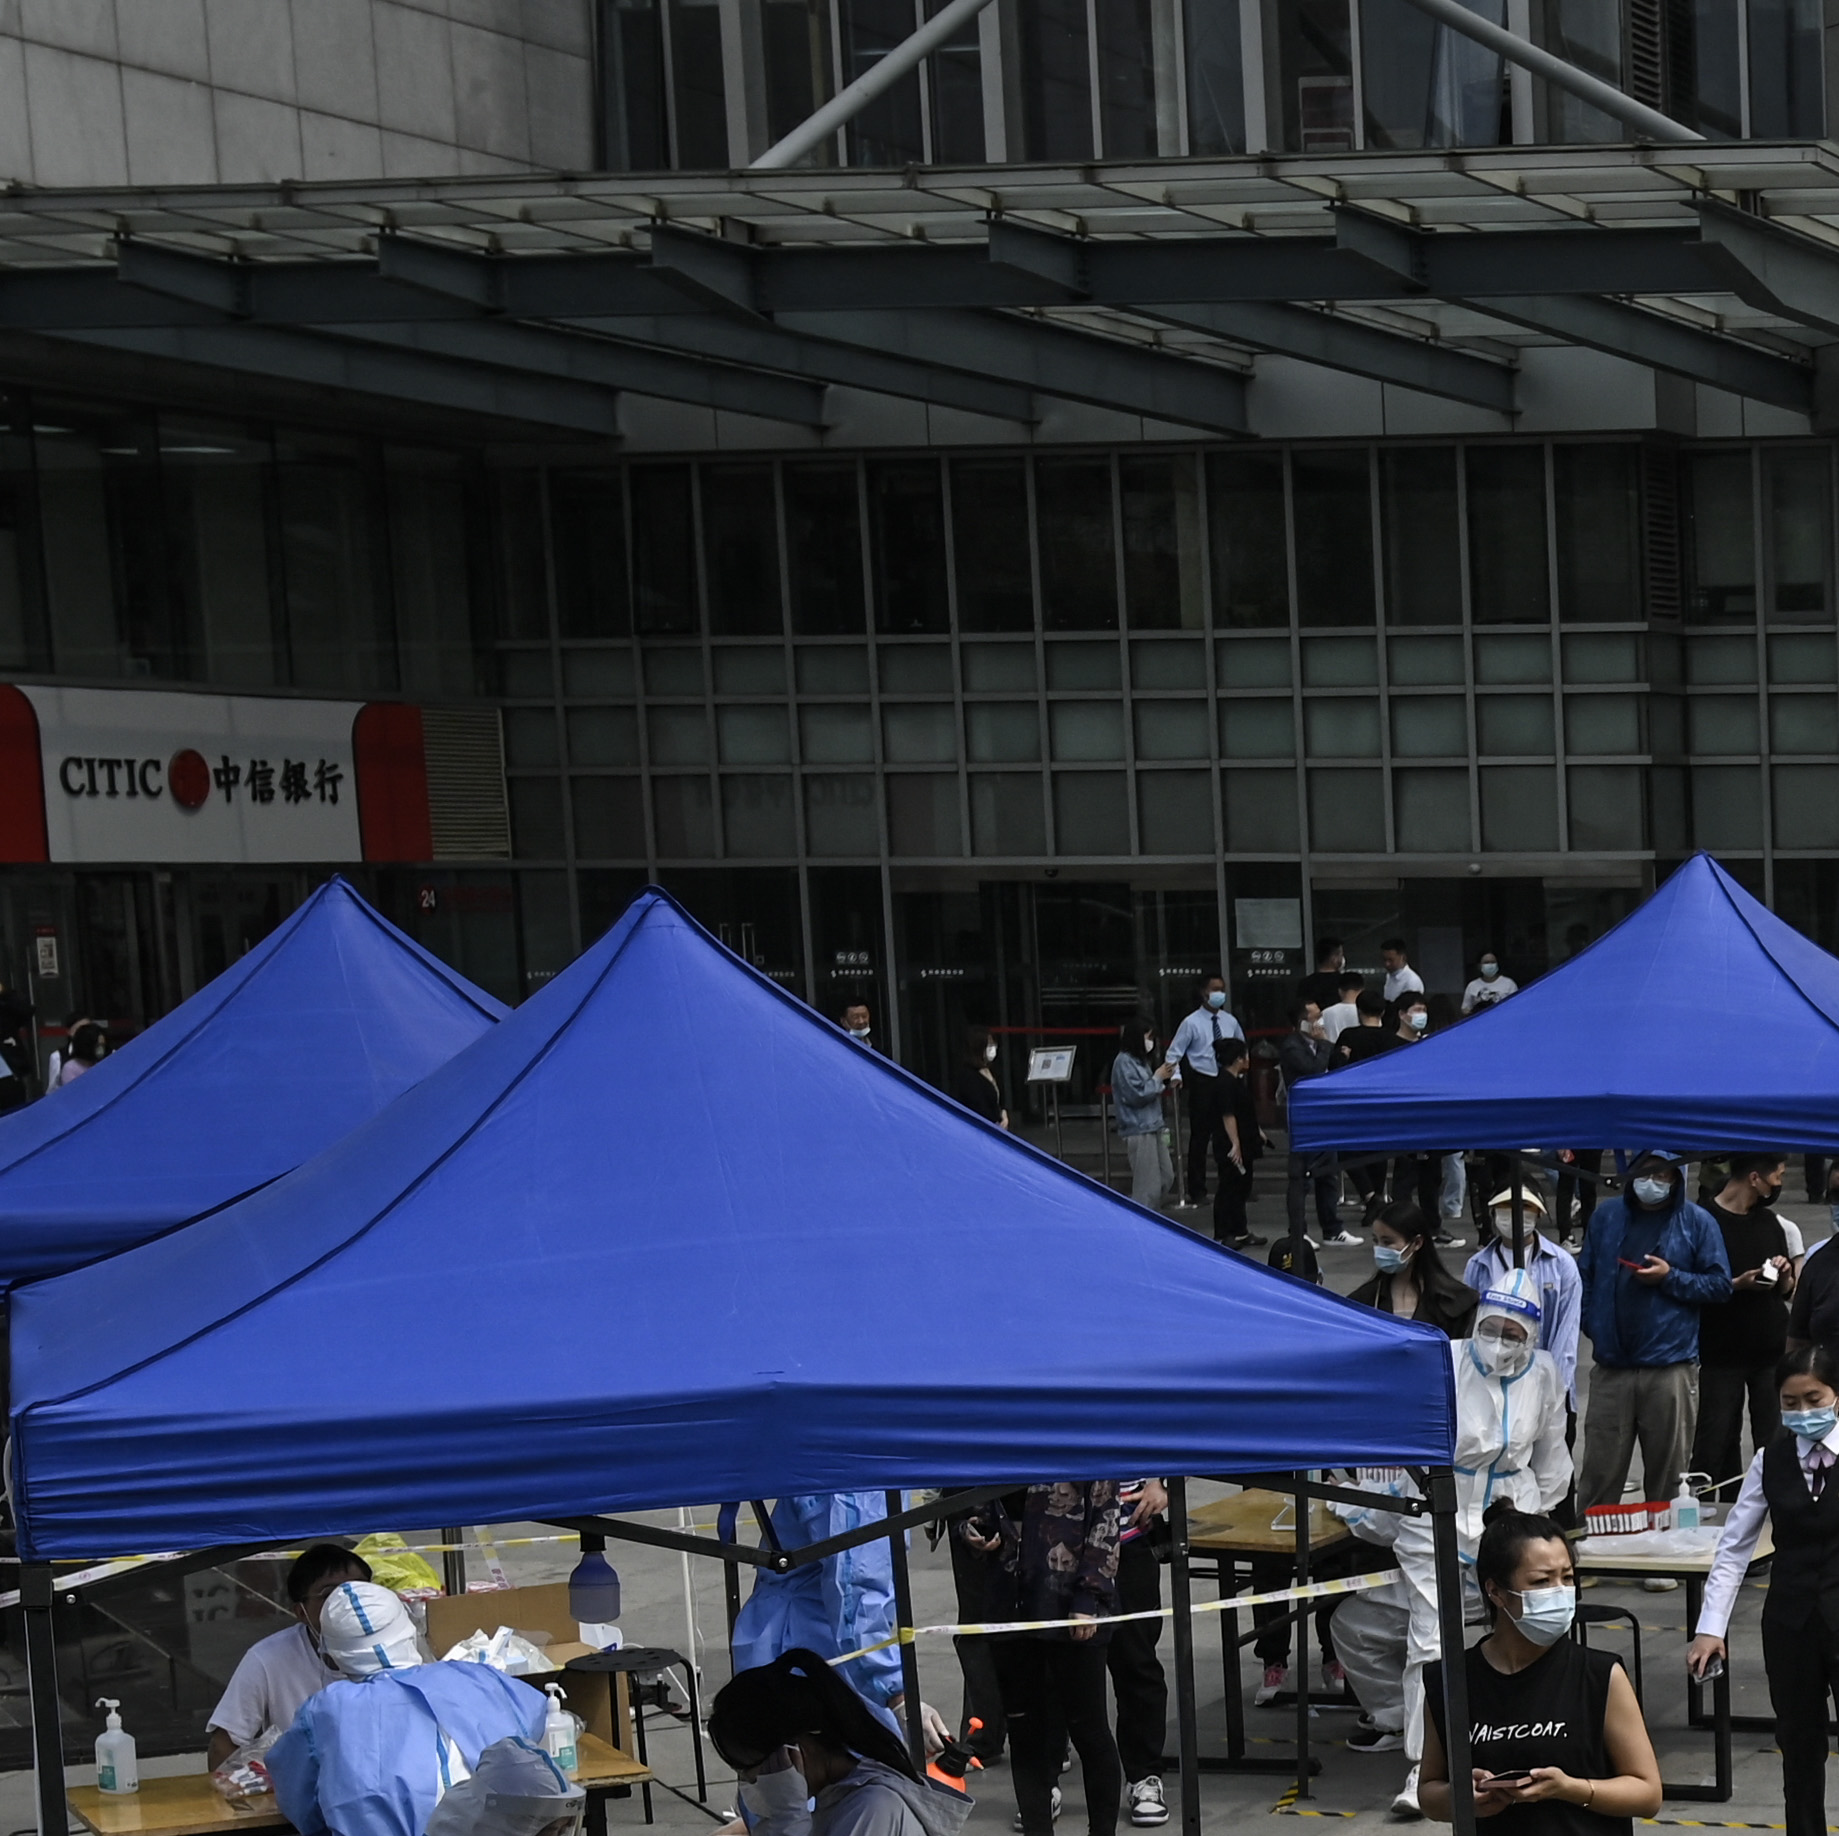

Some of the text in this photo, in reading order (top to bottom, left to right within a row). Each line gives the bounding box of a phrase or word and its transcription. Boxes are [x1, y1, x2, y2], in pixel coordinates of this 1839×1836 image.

[58, 754, 345, 806] CITIC 中信银行
[420, 889, 437, 908] 24
